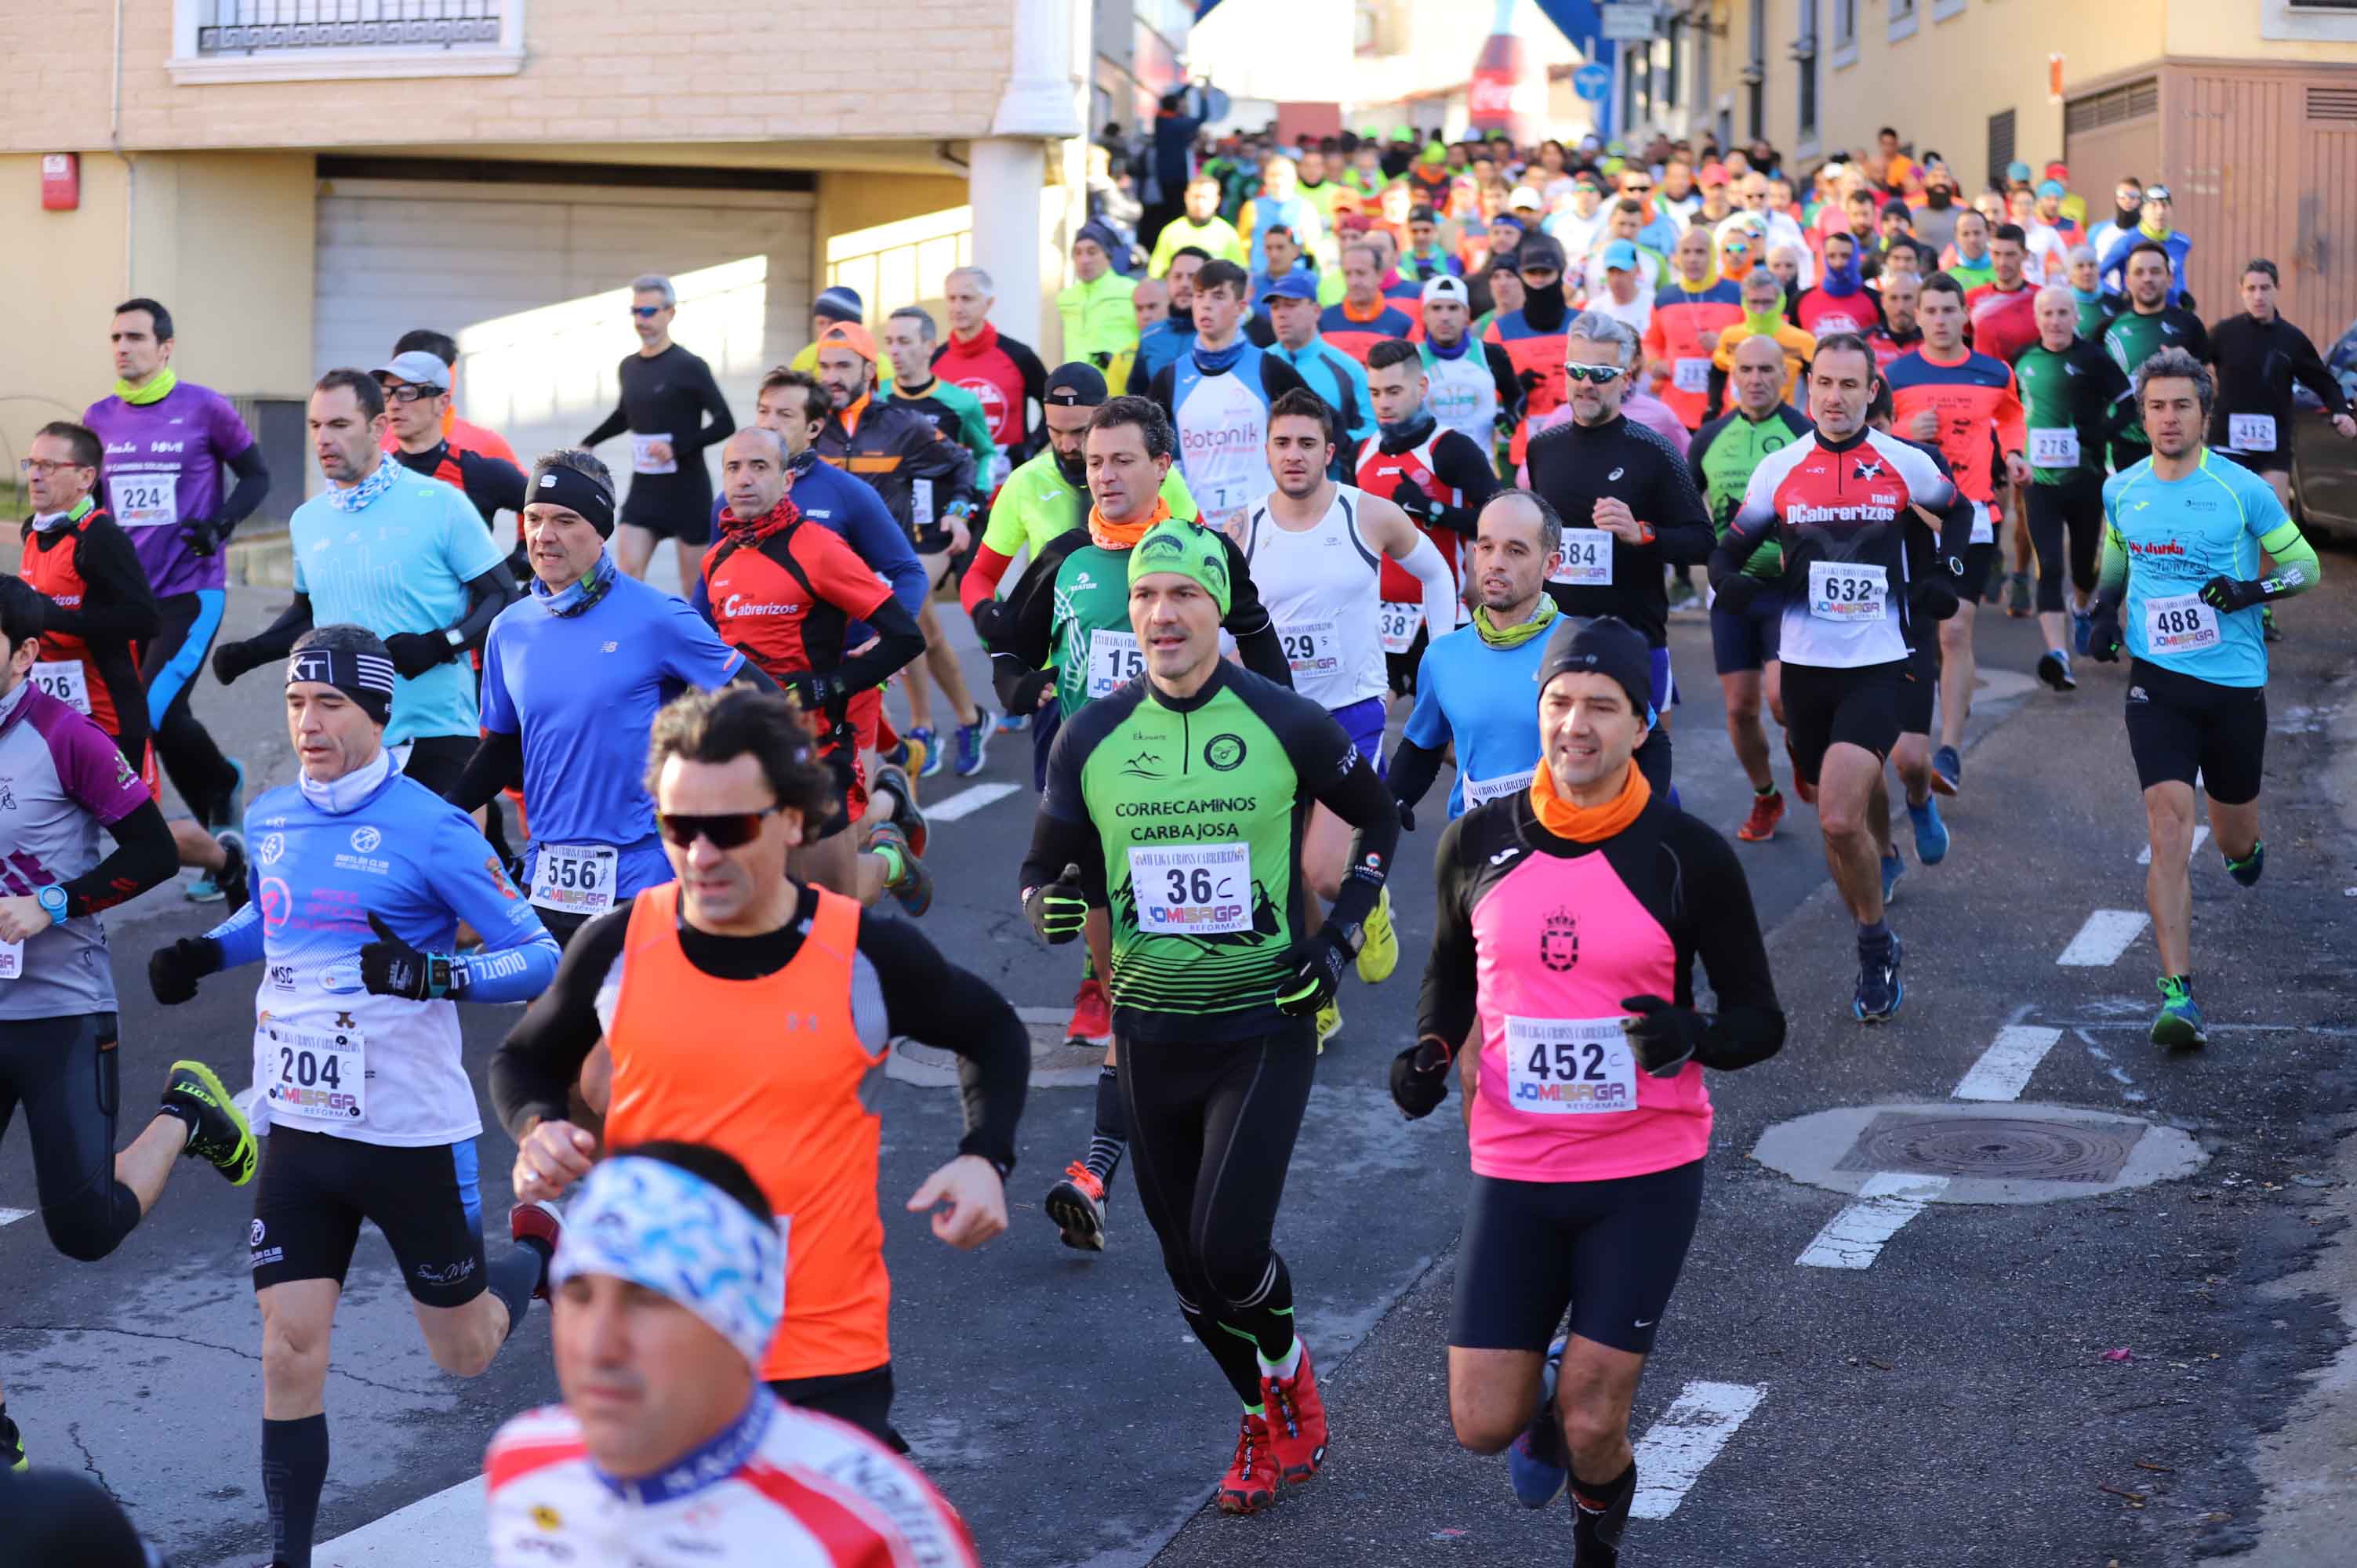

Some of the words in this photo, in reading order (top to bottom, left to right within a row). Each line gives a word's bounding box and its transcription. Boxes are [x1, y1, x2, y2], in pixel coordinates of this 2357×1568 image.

[1182, 423, 1258, 448] Botanik
[124, 488, 161, 508] 224
[1870, 494, 1896, 505] TRAIL
[1825, 577, 1872, 602] 632
[724, 593, 800, 618] Cabrerizos
[2158, 608, 2201, 633] 488
[1284, 634, 1315, 659] 29
[35, 676, 71, 699] 26
[1499, 777, 1534, 793] CABRERIZ
[1116, 797, 1257, 817] CORRECAMINOS
[1131, 822, 1240, 841] CARBAJOSA
[1171, 852, 1197, 865] CROSS
[548, 856, 596, 890] 556
[1167, 868, 1212, 904] 36
[1216, 877, 1234, 898] C
[281, 1047, 340, 1090] 204
[1527, 1044, 1606, 1081] 452
[1516, 1081, 1626, 1102] JOMISAGA
[303, 1105, 351, 1118] REFORMA
